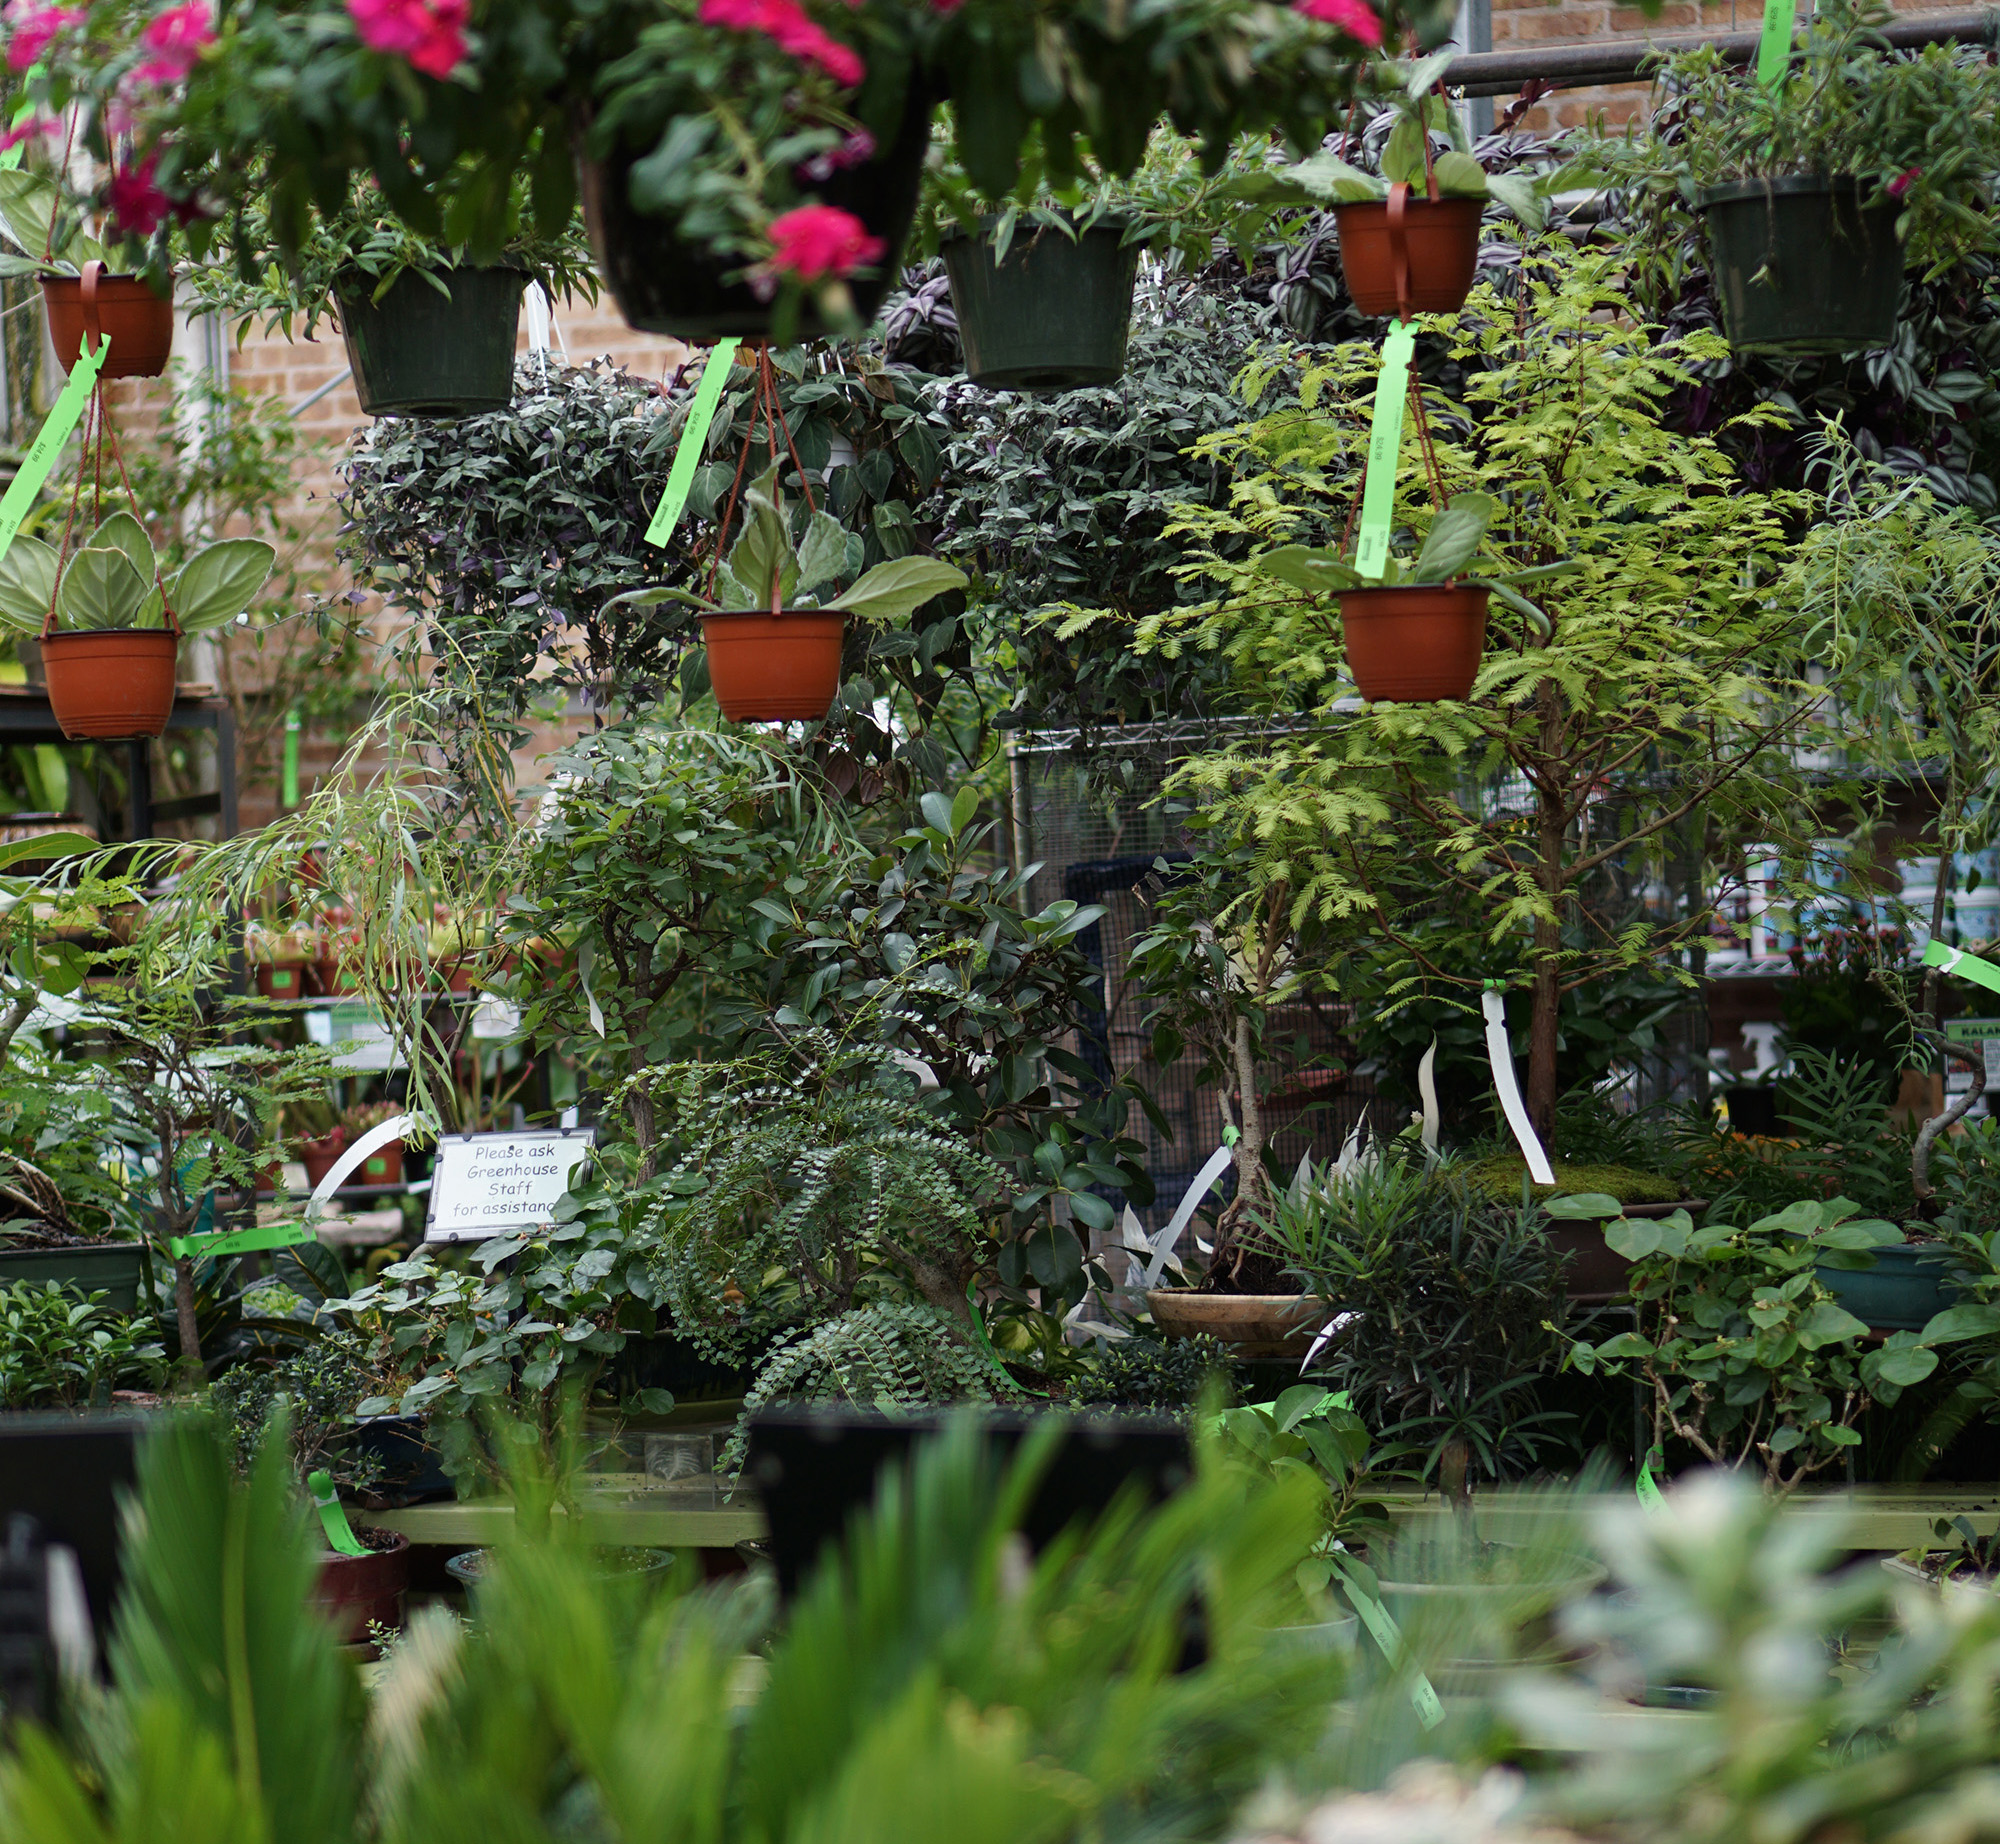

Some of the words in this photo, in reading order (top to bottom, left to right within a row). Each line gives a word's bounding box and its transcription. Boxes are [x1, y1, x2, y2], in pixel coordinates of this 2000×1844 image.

[689, 412, 701, 435] $24.99
[31, 441, 47, 463] $24.99
[1374, 436, 1385, 461] $24.99
[475, 1145, 524, 1160] Please
[528, 1143, 555, 1157] ask
[467, 1163, 559, 1179] Greenhouse
[488, 1180, 534, 1196] Staff
[453, 1202, 478, 1217] for
[482, 1200, 555, 1215] assistanc
